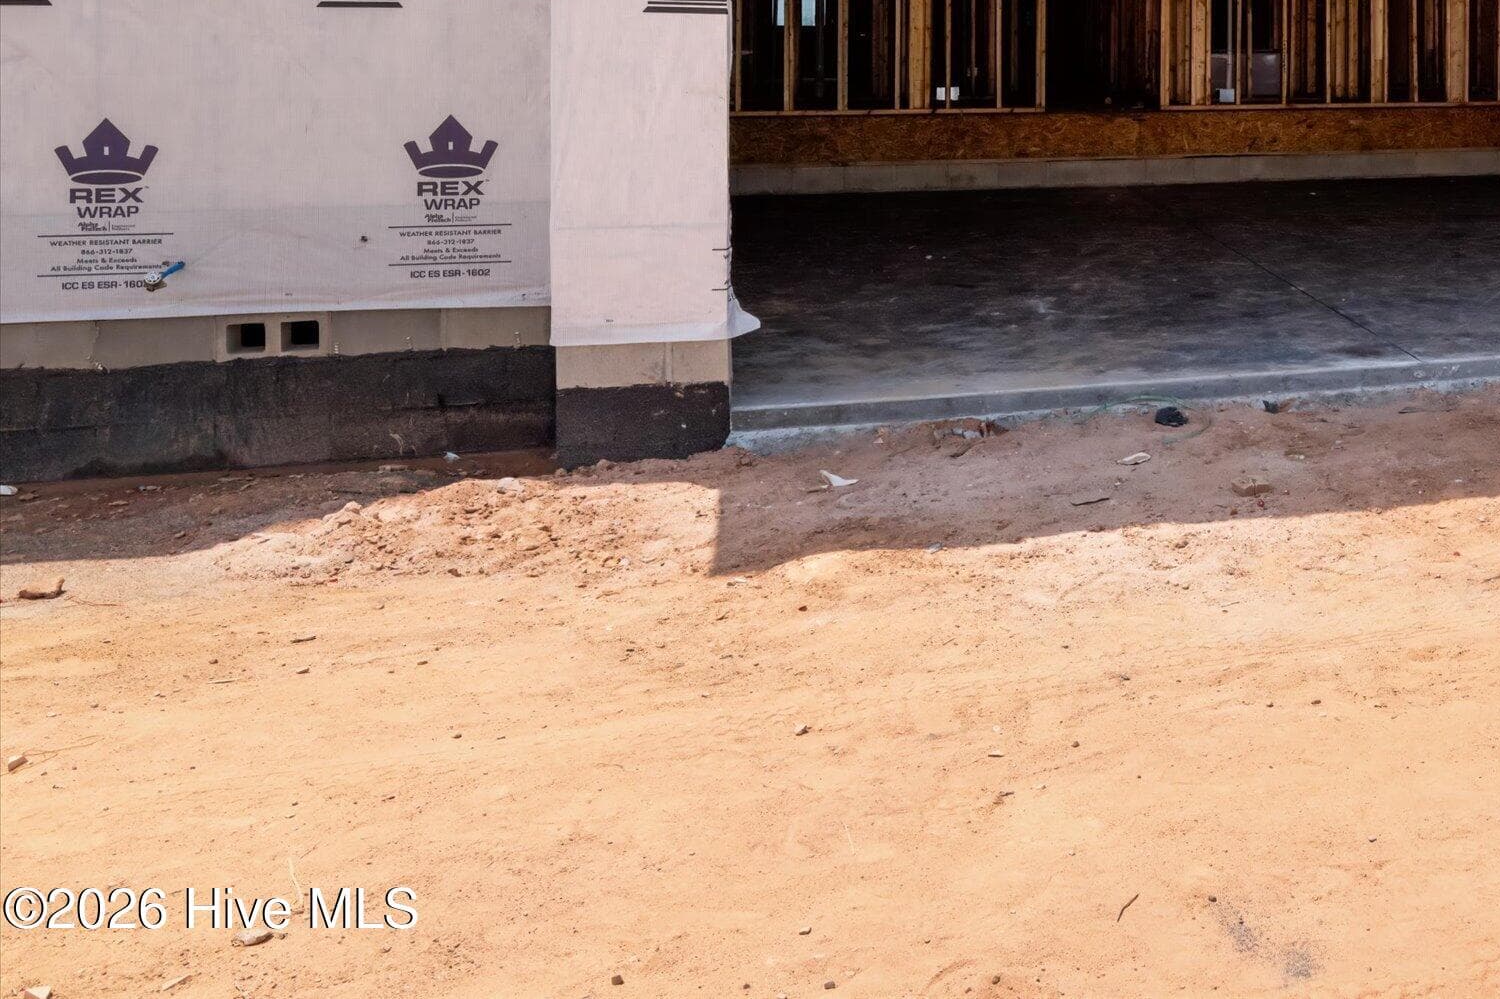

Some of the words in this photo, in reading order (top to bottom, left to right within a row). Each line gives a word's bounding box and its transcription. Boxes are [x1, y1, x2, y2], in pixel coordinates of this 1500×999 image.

[417, 180, 485, 196] REX
[69, 187, 145, 204] REX
[424, 198, 480, 210] WRAP
[77, 205, 140, 219] WRAP
[116, 263, 162, 271] Requirements
[428, 270, 441, 278] ES
[62, 281, 79, 290] ICC
[81, 281, 95, 290] ES
